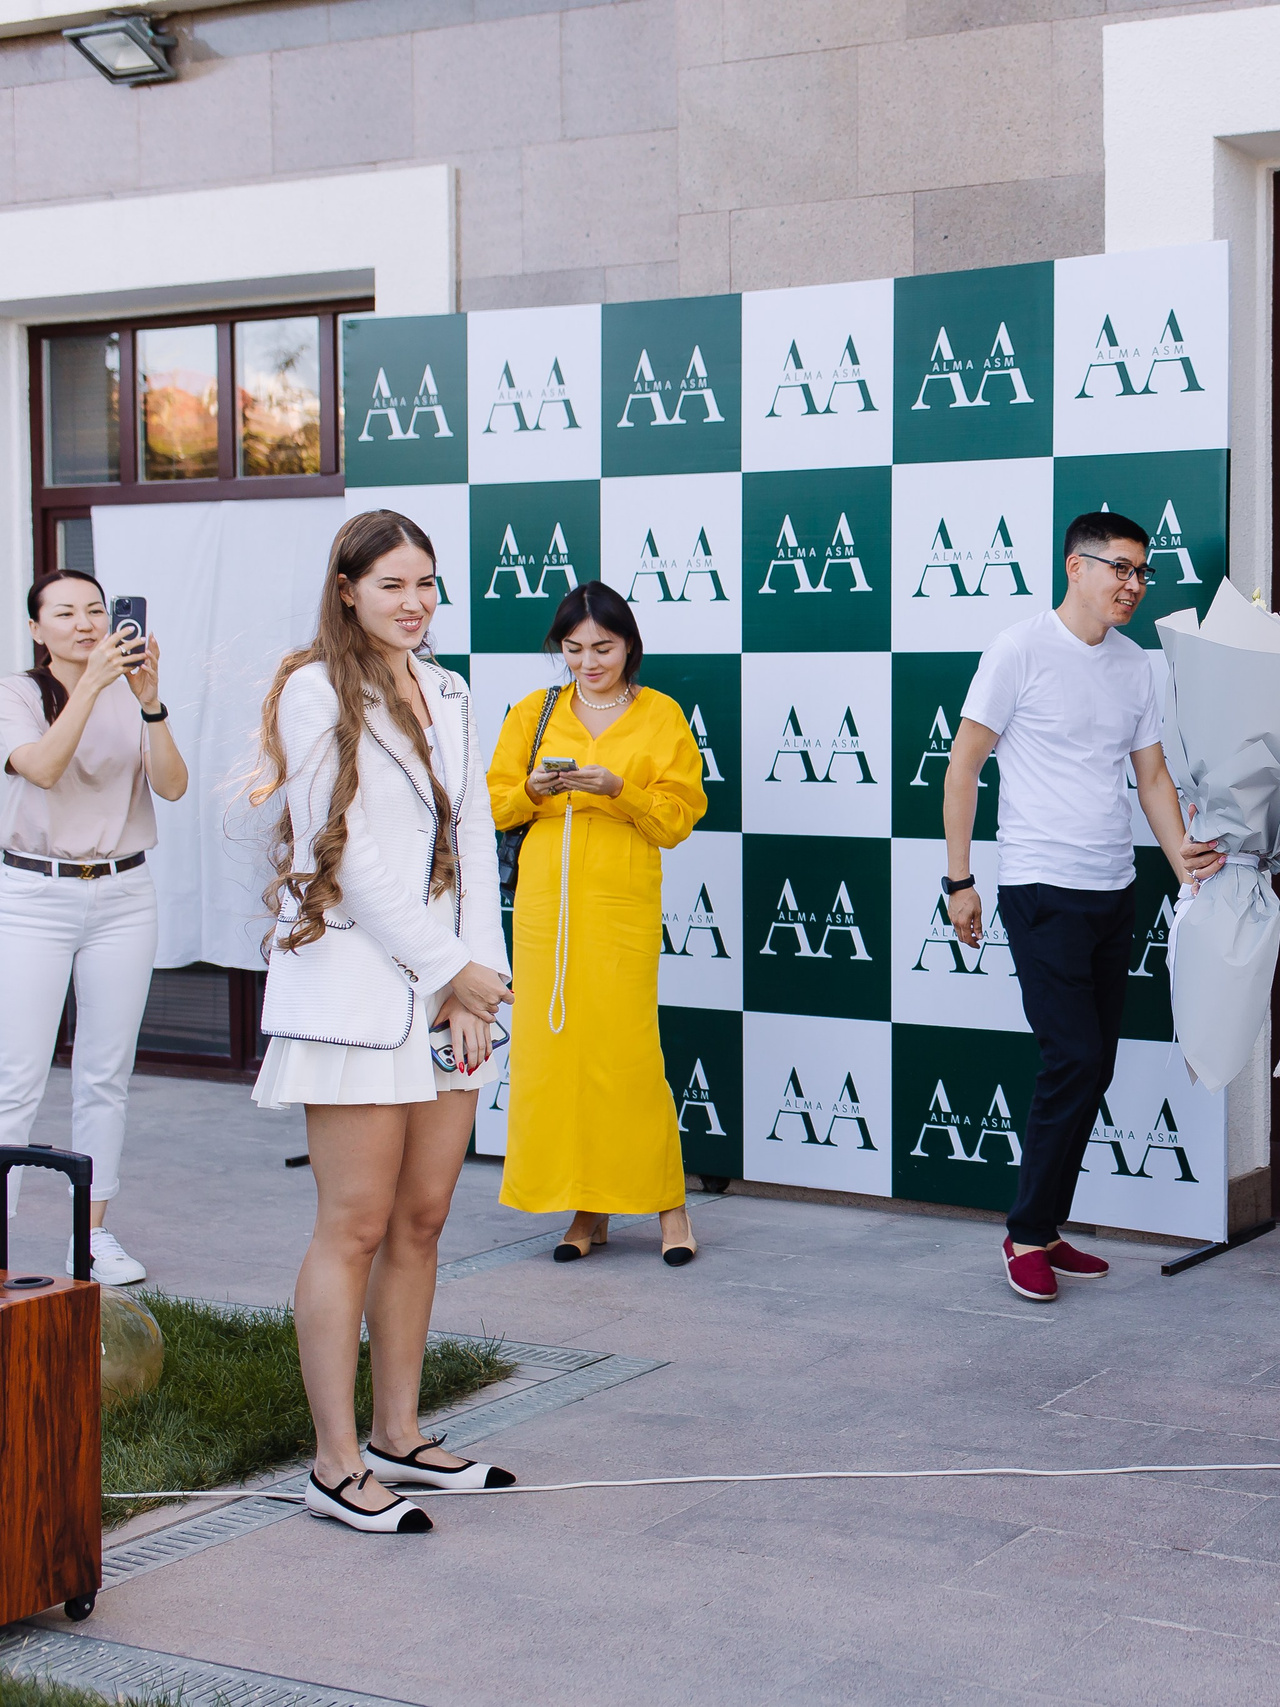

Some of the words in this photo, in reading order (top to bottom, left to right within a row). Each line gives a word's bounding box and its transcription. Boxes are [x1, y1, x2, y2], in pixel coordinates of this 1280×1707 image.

[1075, 308, 1205, 399] AA
[1097, 347, 1141, 360] ALMA
[1152, 344, 1185, 356] ASM
[911, 321, 1034, 410] AA
[932, 359, 973, 373] ALMA
[983, 357, 1016, 369] ASM
[765, 334, 879, 418] AA
[784, 371, 823, 382] ALMA
[832, 368, 861, 379] ASM
[499, 389, 533, 400] ALMA
[541, 387, 566, 399] ASM
[617, 345, 725, 428] AA
[635, 380, 672, 393] ALMA
[679, 378, 708, 390] ASM
[358, 364, 454, 442] AA
[373, 396, 407, 409] ALMA
[413, 395, 439, 407] ASM
[482, 356, 582, 435] AA
[1148, 536, 1182, 547] ASM
[758, 512, 873, 594] AA
[777, 547, 817, 558] ALMA
[825, 545, 855, 557] ASM
[912, 515, 1033, 598] AA
[932, 551, 973, 562] ALMA
[983, 549, 1015, 561] ASM
[484, 522, 579, 598] AA
[500, 555, 536, 566] ALMA
[543, 554, 569, 565] ASM
[626, 526, 730, 603] AA
[641, 559, 678, 569] ALMA
[686, 558, 713, 569] ASM
[764, 705, 878, 784] AA
[783, 739, 822, 749] ALMA
[831, 739, 860, 749] ASM
[688, 914, 714, 924] ASM
[759, 878, 873, 961] AA
[778, 911, 817, 923] ALMA
[825, 913, 854, 925] ASM
[1146, 929, 1165, 940] AS
[683, 1089, 709, 1100] ASM
[766, 1066, 879, 1151] AA
[784, 1099, 823, 1111] ALMA
[832, 1103, 860, 1114] ASM
[910, 1078, 1022, 1166] AA
[930, 1112, 971, 1125] ALMA
[981, 1117, 1011, 1129] ASM
[1092, 1127, 1136, 1140] ALMA
[1146, 1132, 1178, 1144] ASM
